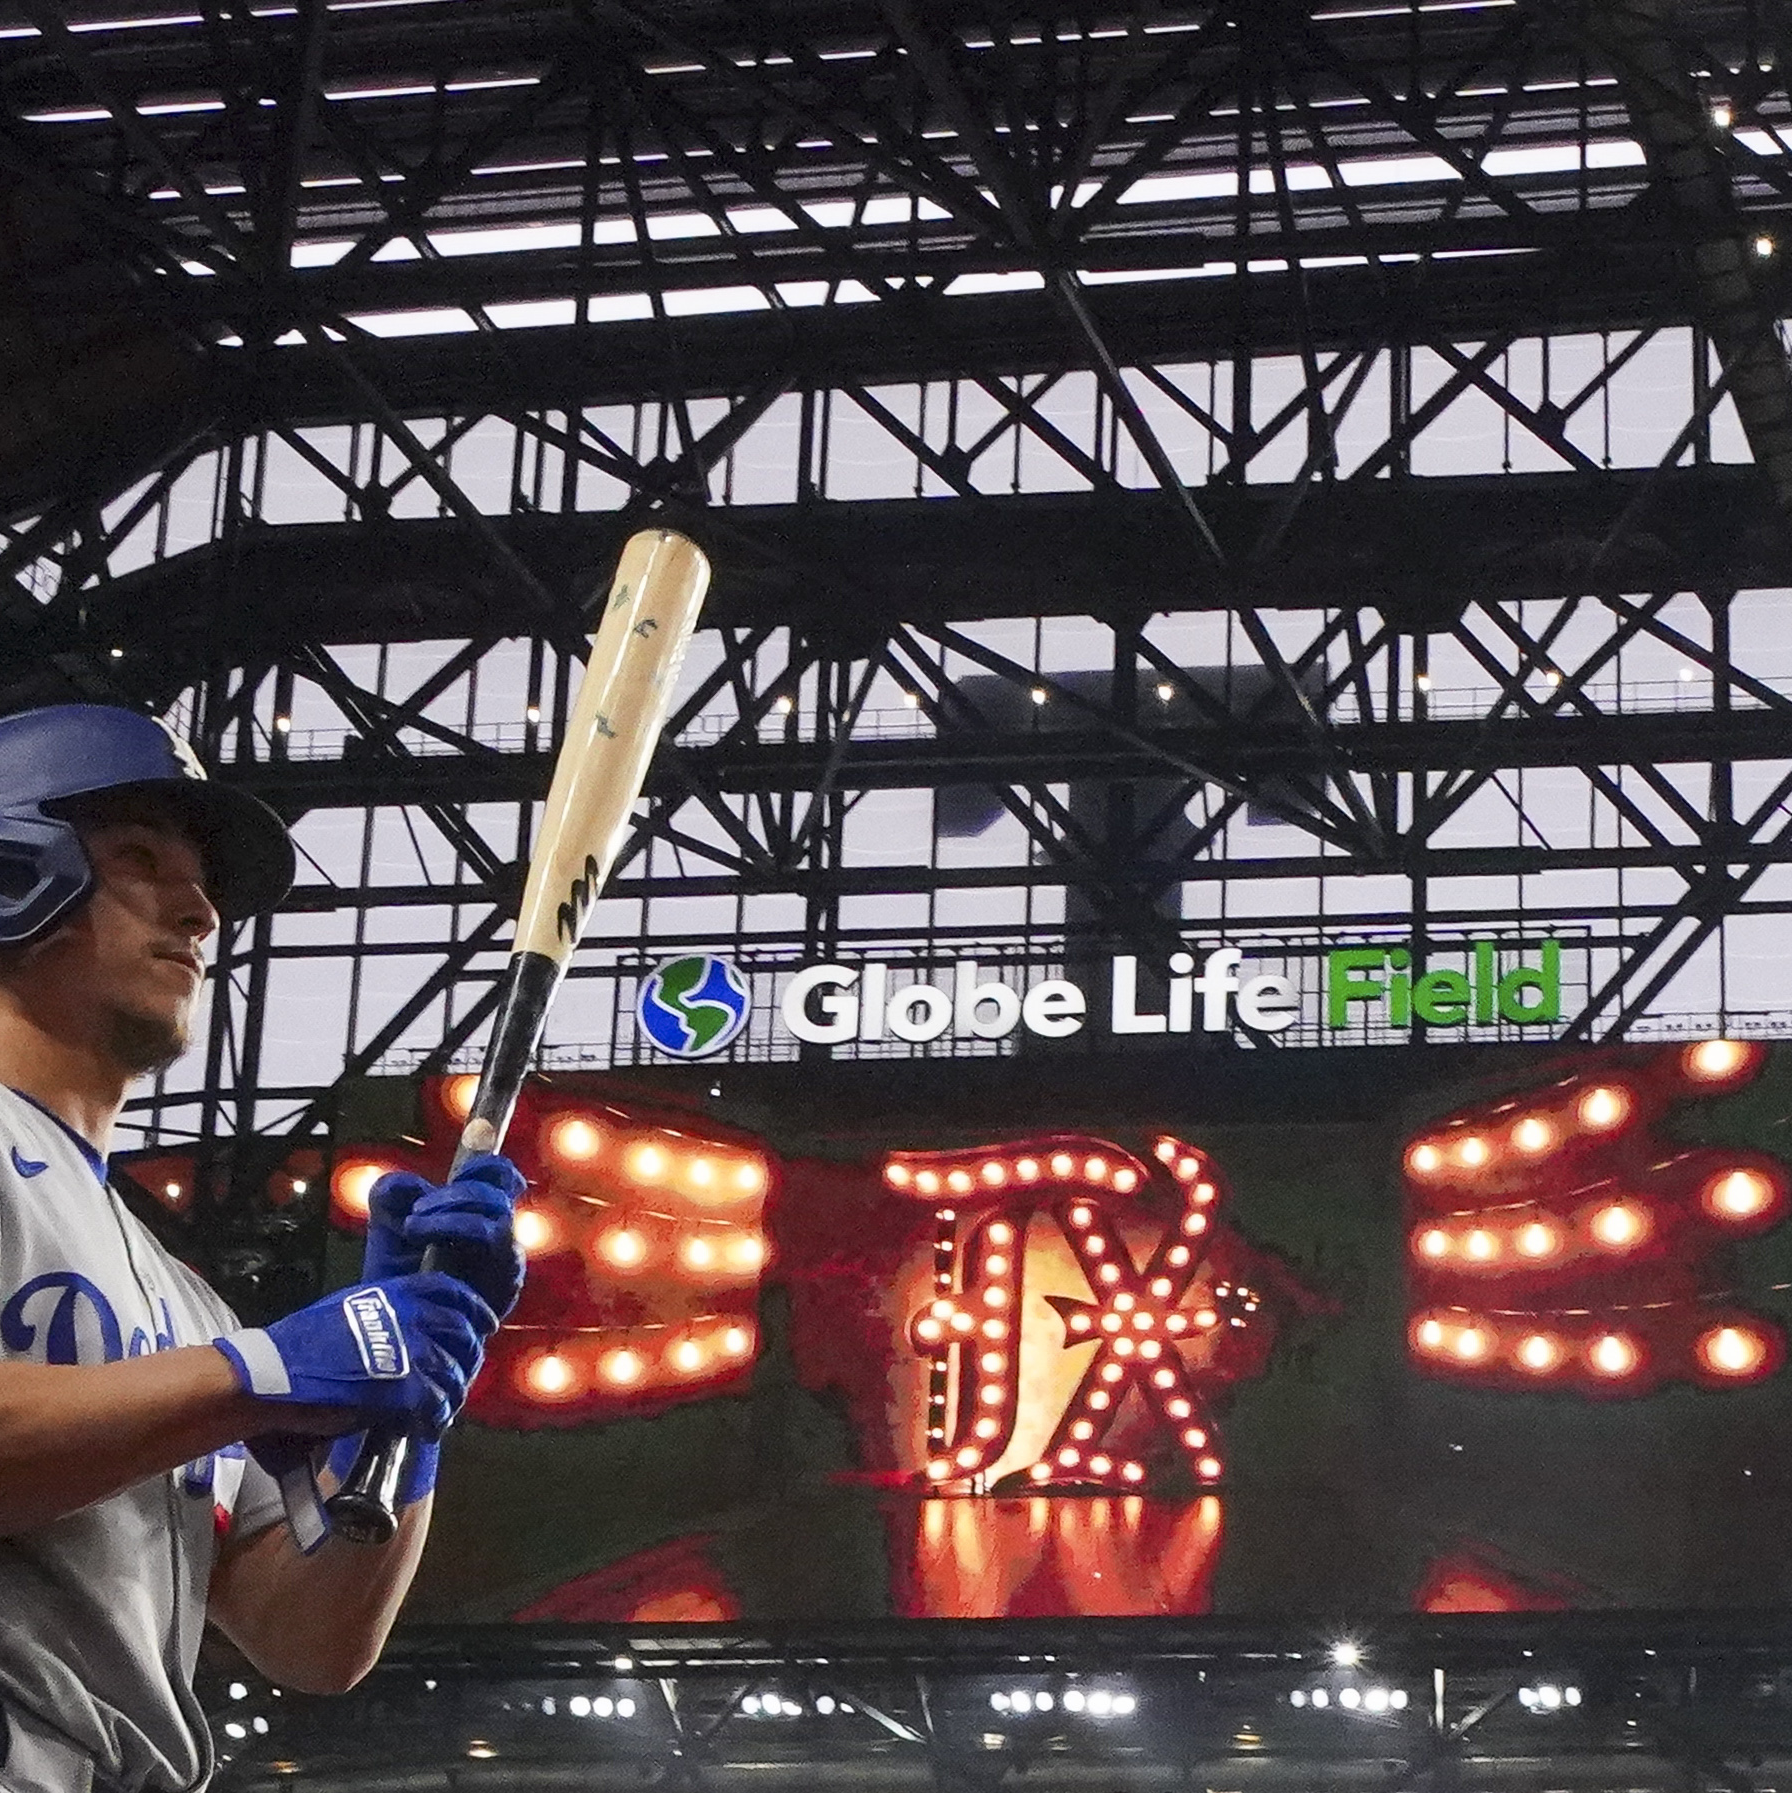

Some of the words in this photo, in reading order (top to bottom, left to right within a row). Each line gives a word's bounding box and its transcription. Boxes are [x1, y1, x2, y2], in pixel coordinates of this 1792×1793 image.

[782, 961, 1087, 1045] Globe
[1112, 948, 1299, 1035] Life
[1325, 940, 1562, 1030] Field
[350, 1297, 397, 1372] Franklin
